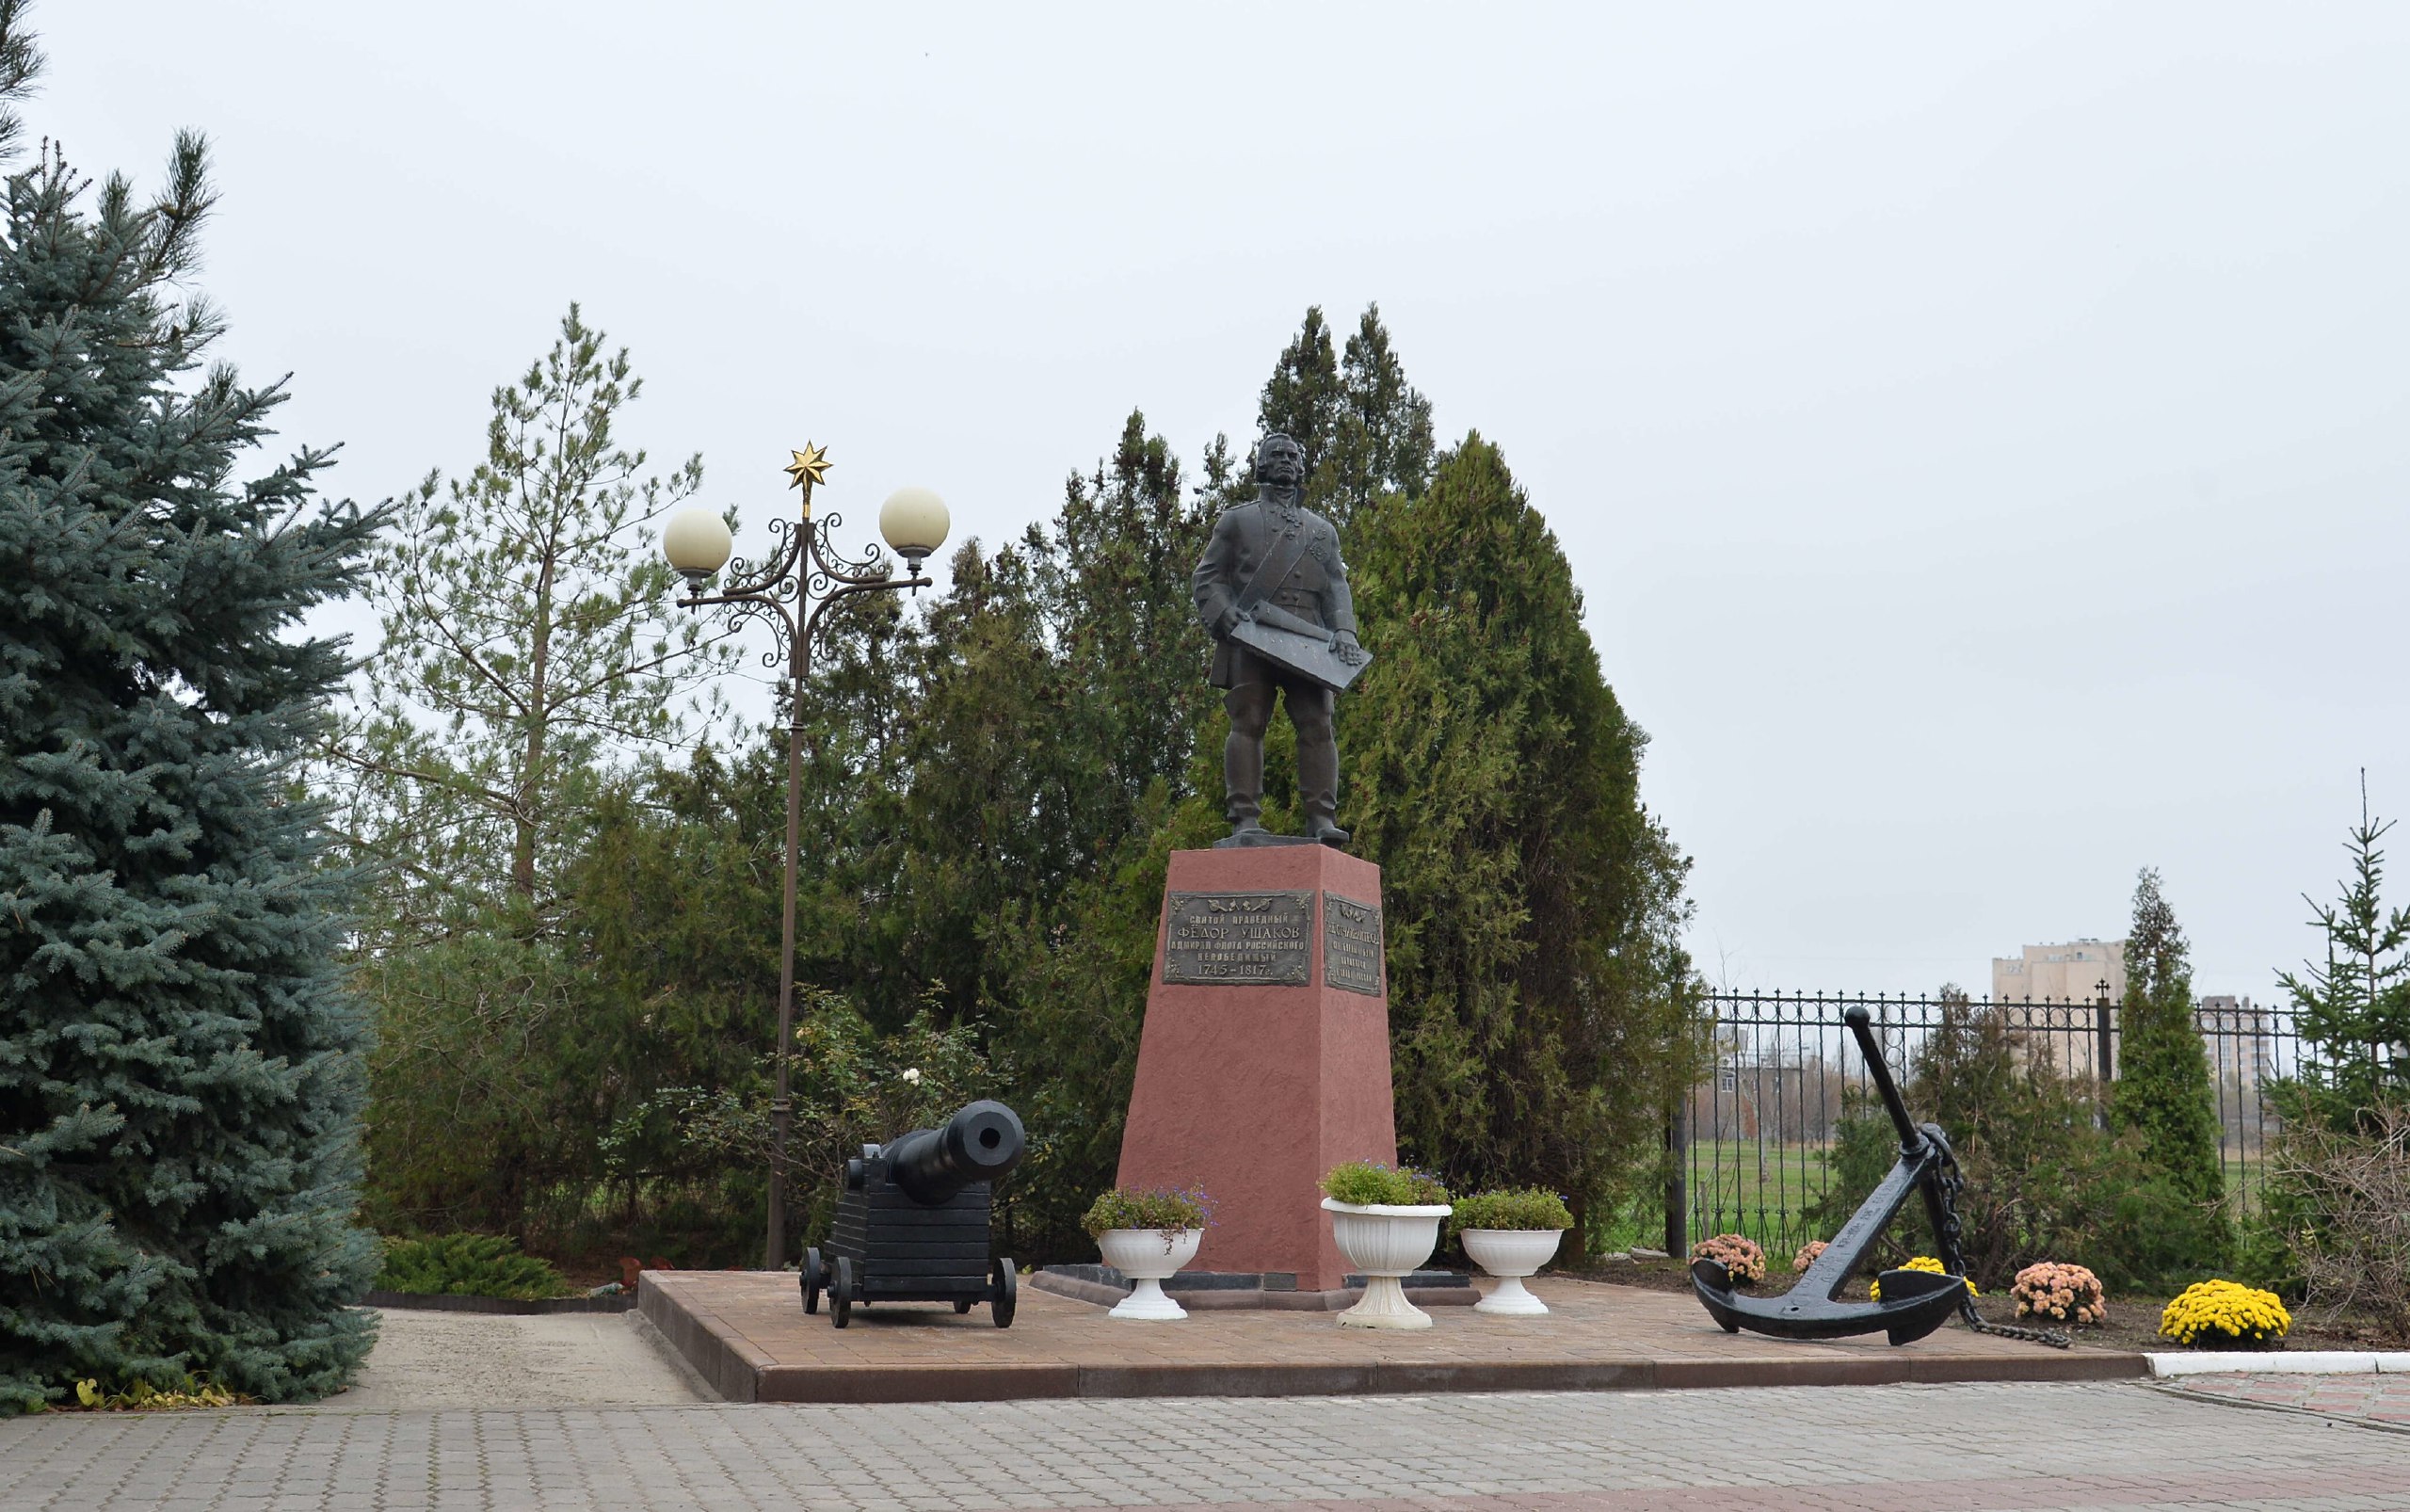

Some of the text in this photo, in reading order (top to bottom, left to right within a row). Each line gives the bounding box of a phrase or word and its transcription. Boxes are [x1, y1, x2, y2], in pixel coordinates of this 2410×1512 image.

[1189, 912, 1288, 925] СВЯТОЙ ПРАВЕДНЫЙ
[1178, 924, 1299, 940] ФЁДОР УШАКОВ
[1171, 940, 1304, 951] АДМИРАЛ ФЛОТА РОССИЙСКОГО
